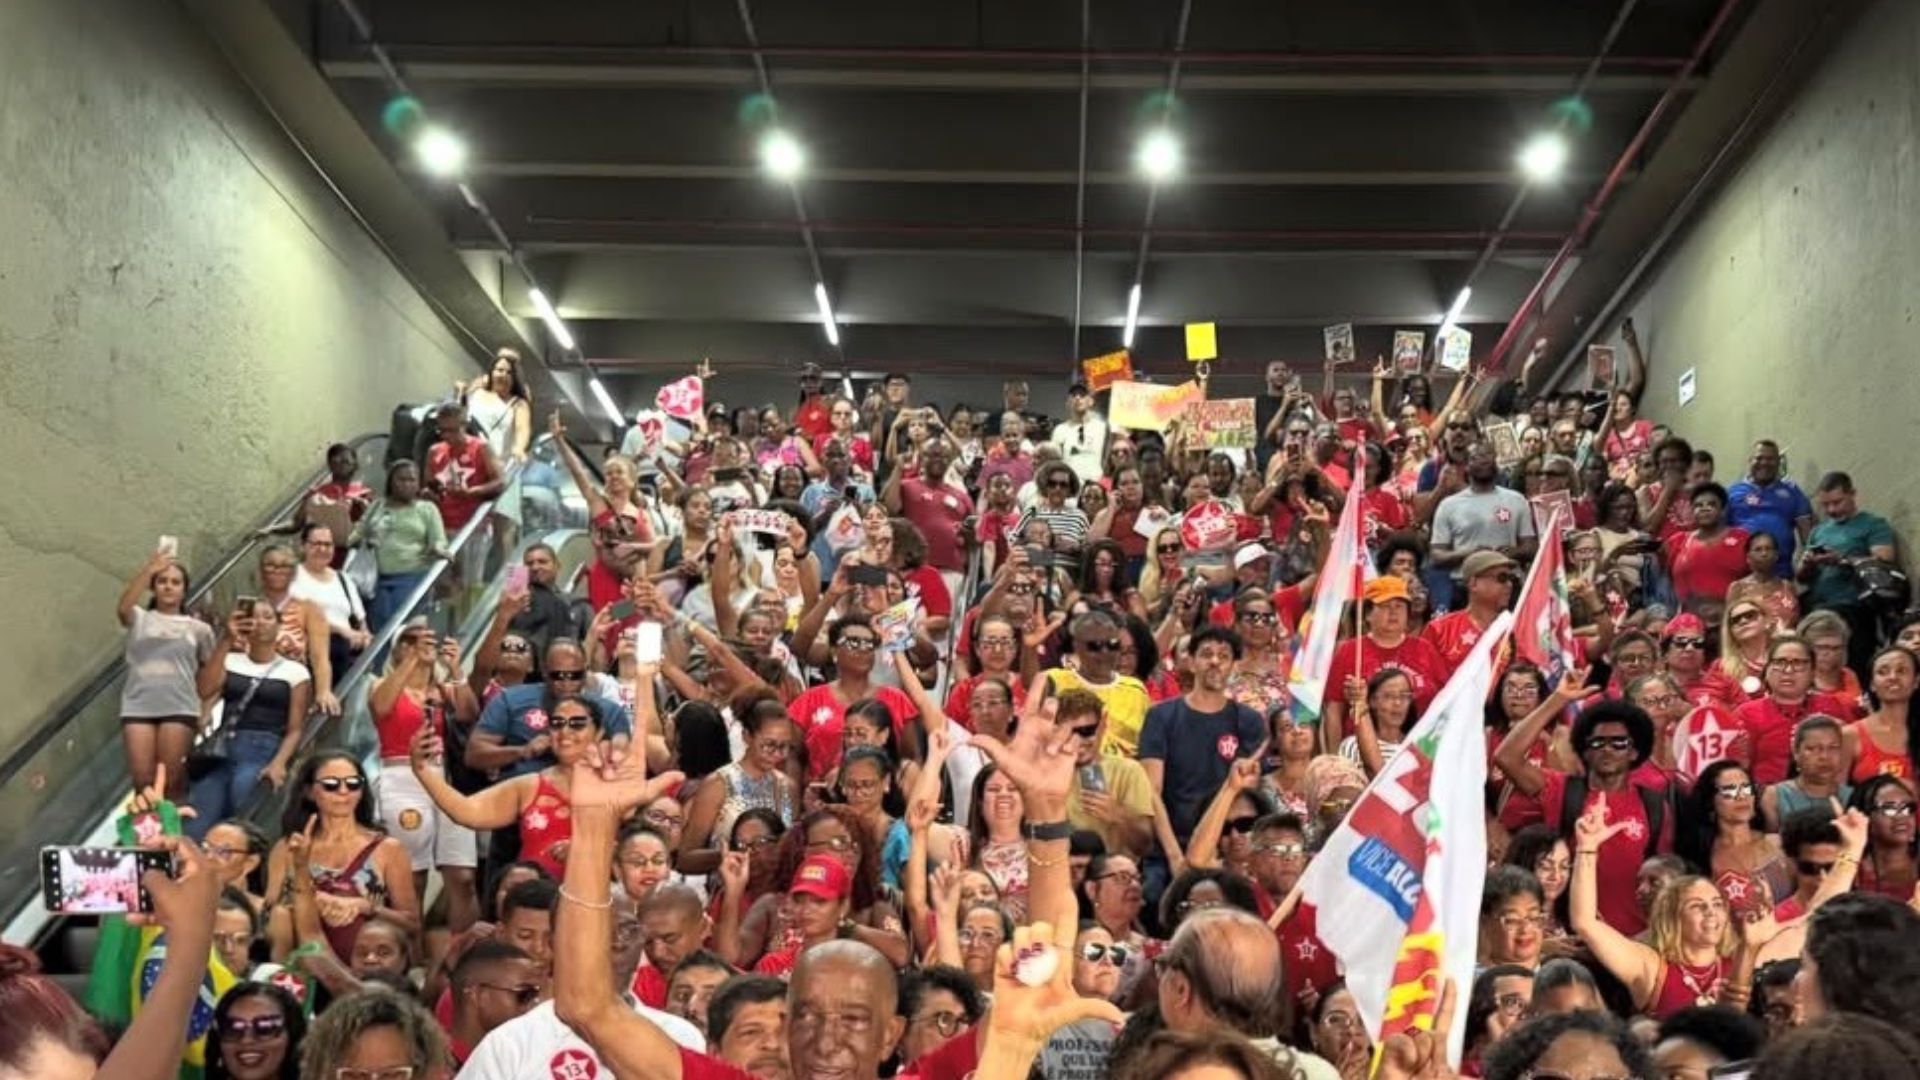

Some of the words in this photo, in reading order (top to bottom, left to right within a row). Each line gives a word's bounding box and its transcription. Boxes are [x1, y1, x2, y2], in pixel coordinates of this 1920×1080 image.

[1698, 733, 1723, 760] 13
[1356, 838, 1396, 878] VICE
[564, 1063, 582, 1078] 13
